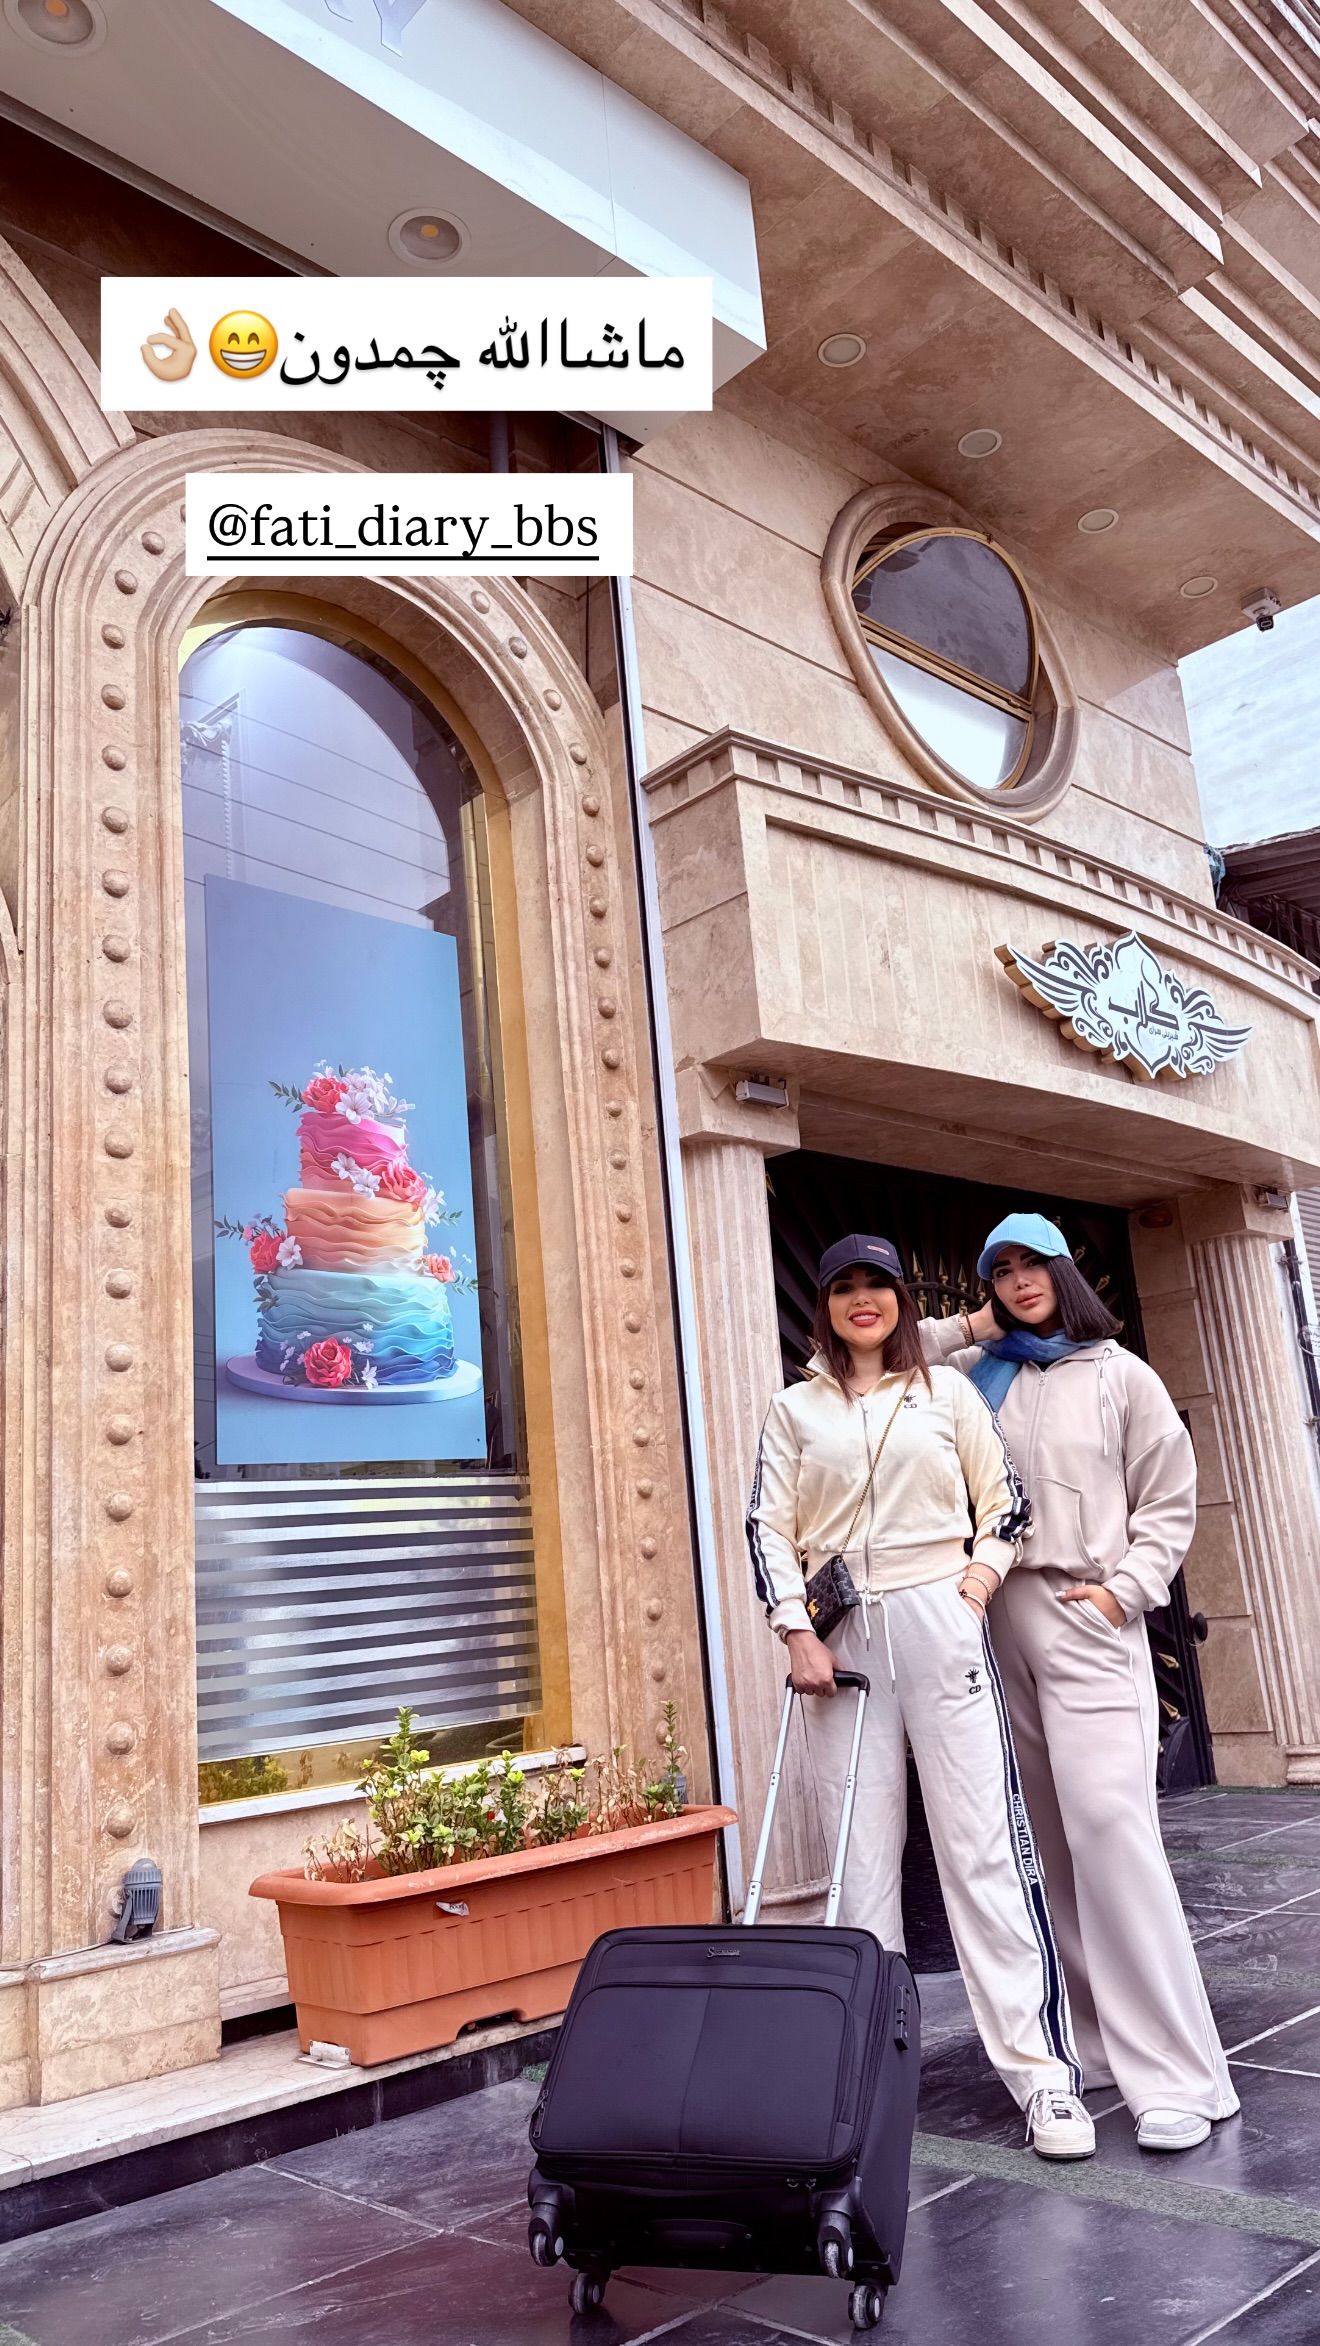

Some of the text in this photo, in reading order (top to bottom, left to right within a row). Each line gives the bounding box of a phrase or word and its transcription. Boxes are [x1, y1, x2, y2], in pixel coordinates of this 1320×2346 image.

[968, 1684, 982, 1695] CD
[1012, 1793, 1039, 1886] CHRISTIAN DIRA
